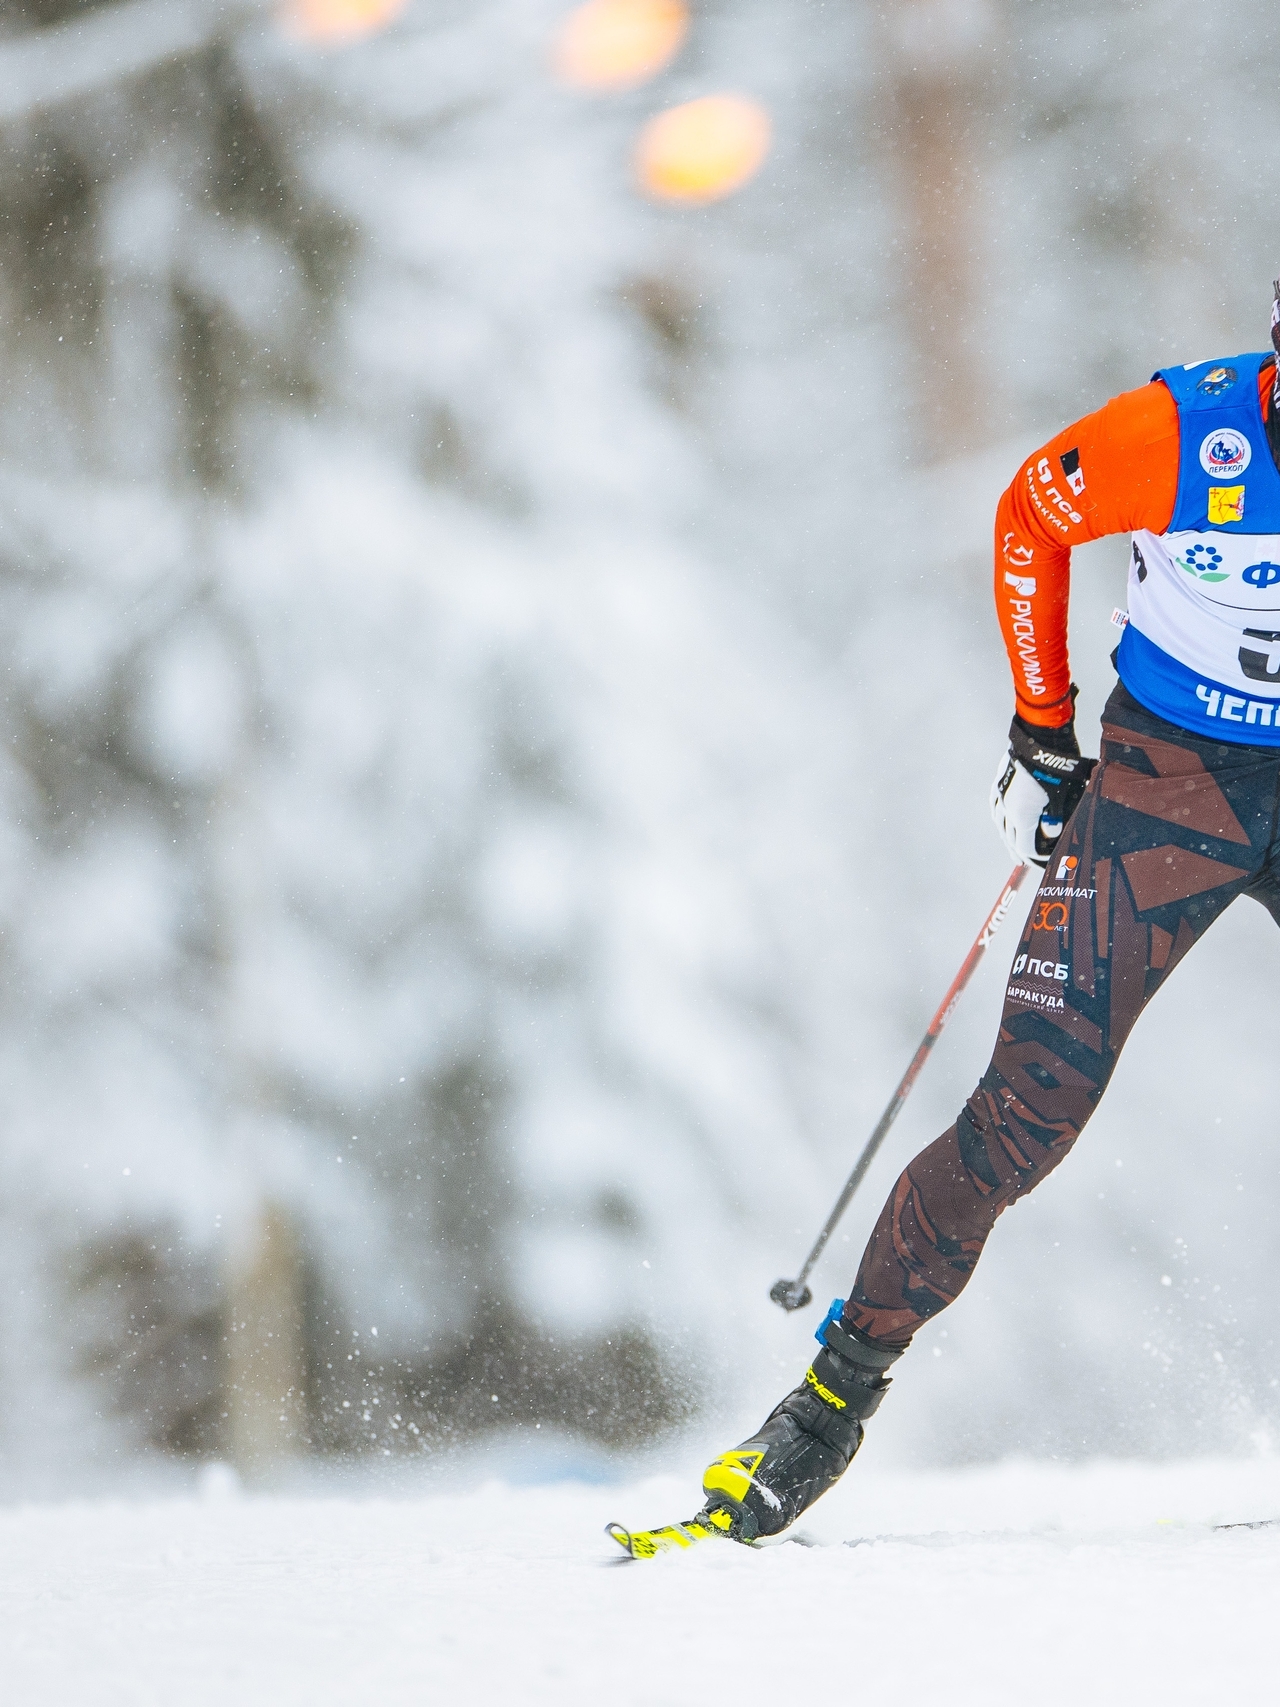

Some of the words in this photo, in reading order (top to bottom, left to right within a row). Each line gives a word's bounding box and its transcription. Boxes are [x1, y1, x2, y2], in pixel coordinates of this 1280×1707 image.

[1209, 464, 1244, 473] ПЕРЕКОП
[1046, 487, 1083, 524] ПСБ
[1033, 902, 1068, 931] 30
[1026, 958, 1069, 981] ПСБ
